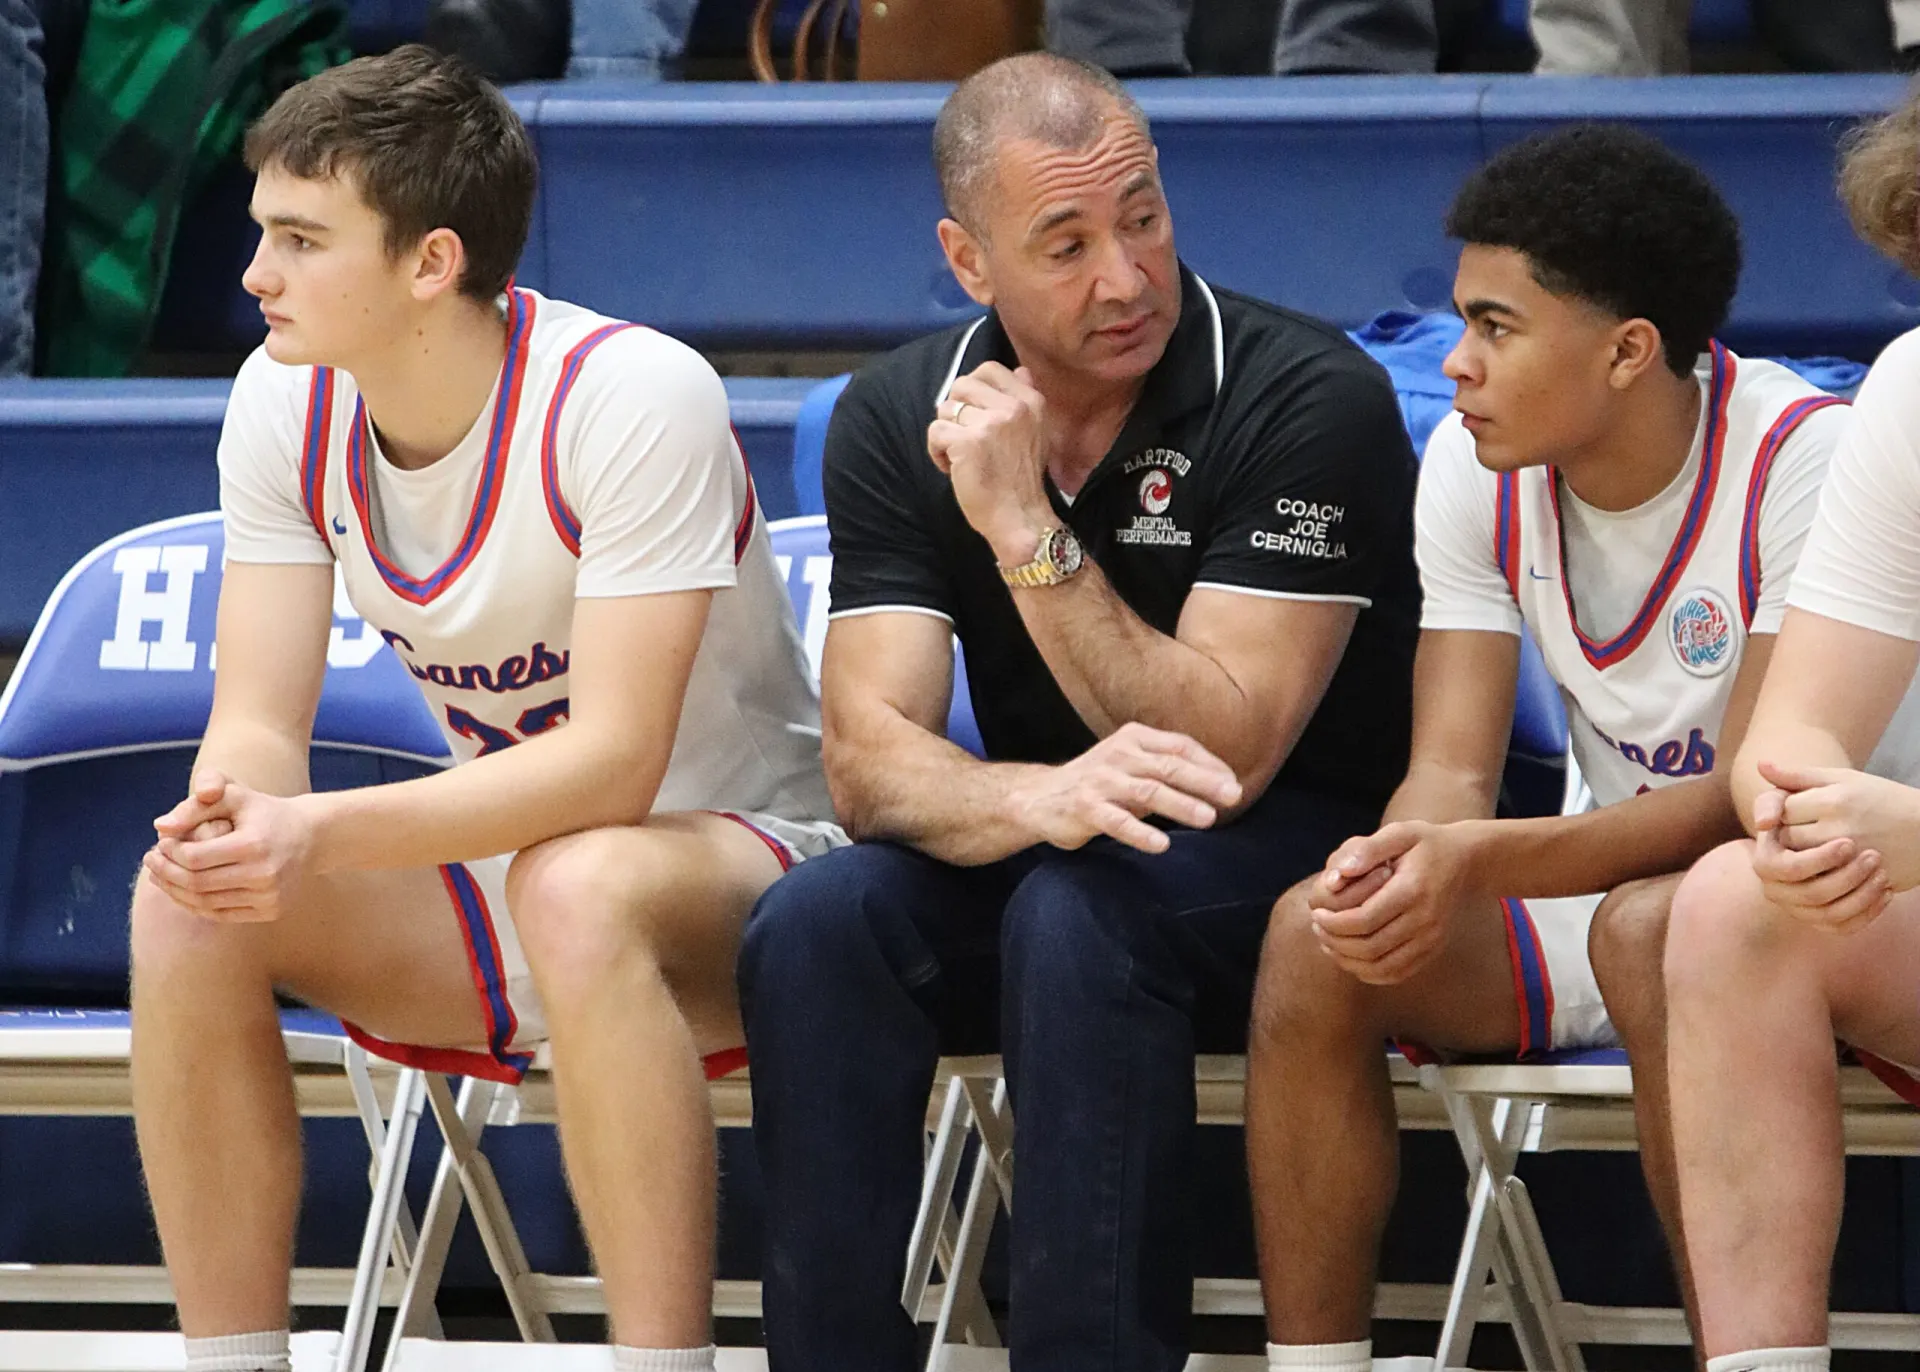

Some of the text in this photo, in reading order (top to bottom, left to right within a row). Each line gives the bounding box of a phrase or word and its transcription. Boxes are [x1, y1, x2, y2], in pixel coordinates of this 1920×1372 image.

[1123, 448, 1192, 477] HARTFORD
[1276, 498, 1345, 523] COACH
[1132, 516, 1176, 531] MENTAL
[1289, 519, 1329, 539] JOE
[1116, 529, 1192, 546] PERFORMANCE
[1250, 530, 1348, 559] CERNIGLIA
[99, 545, 385, 671] HS
